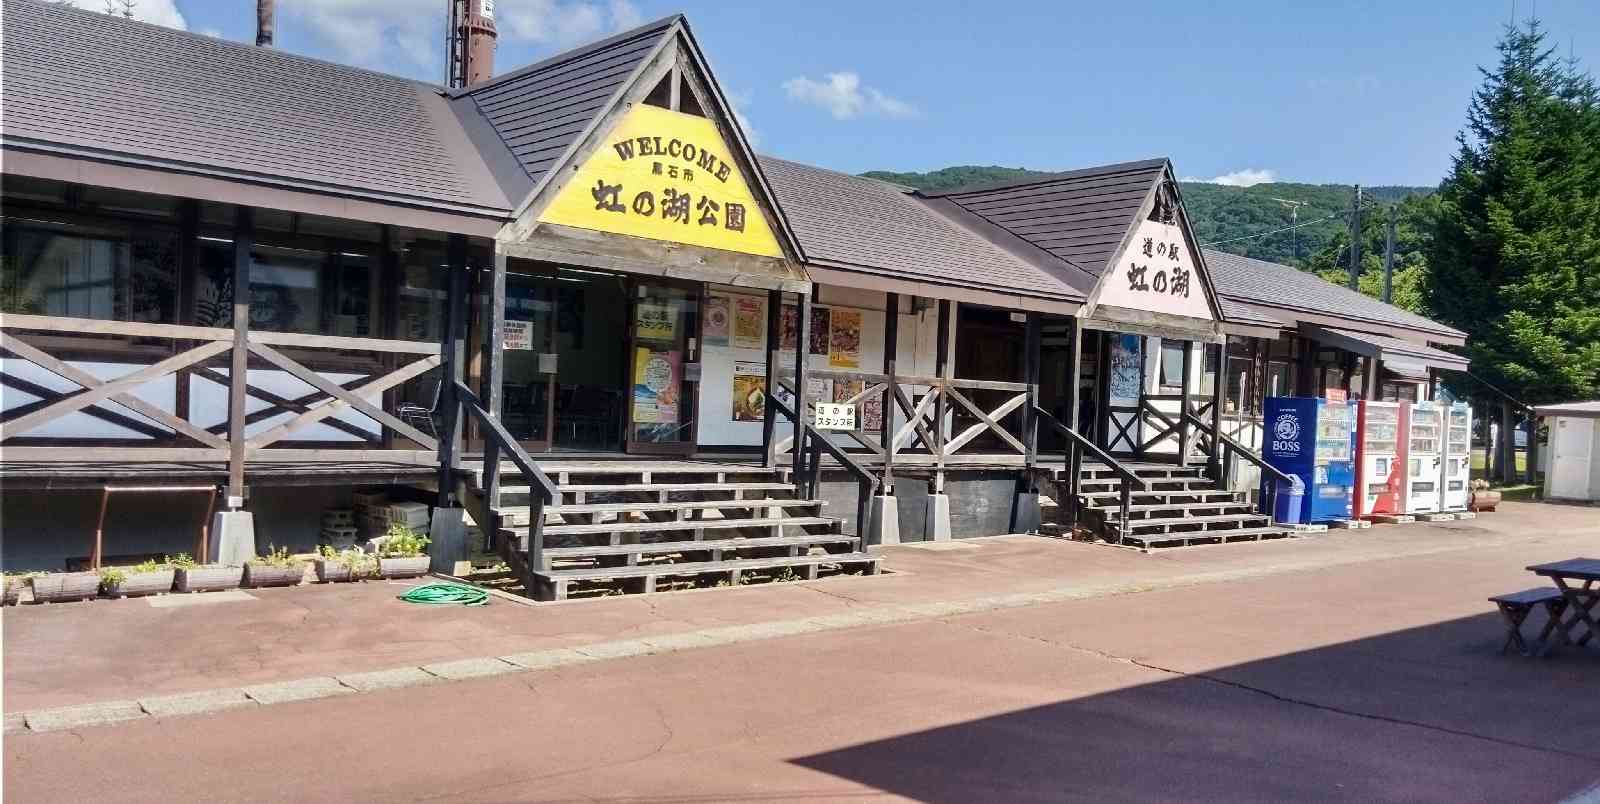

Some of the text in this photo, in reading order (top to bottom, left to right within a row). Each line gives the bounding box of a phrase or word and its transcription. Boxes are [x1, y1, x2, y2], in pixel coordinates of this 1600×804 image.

[613, 136, 731, 183] WELCOME
[652, 161, 694, 182] 黒石市
[591, 179, 746, 233] 虹の湖公園
[1142, 237, 1180, 261] 道の駅
[1127, 262, 1190, 298] 虹の湖
[1272, 440, 1301, 452] BOSS
